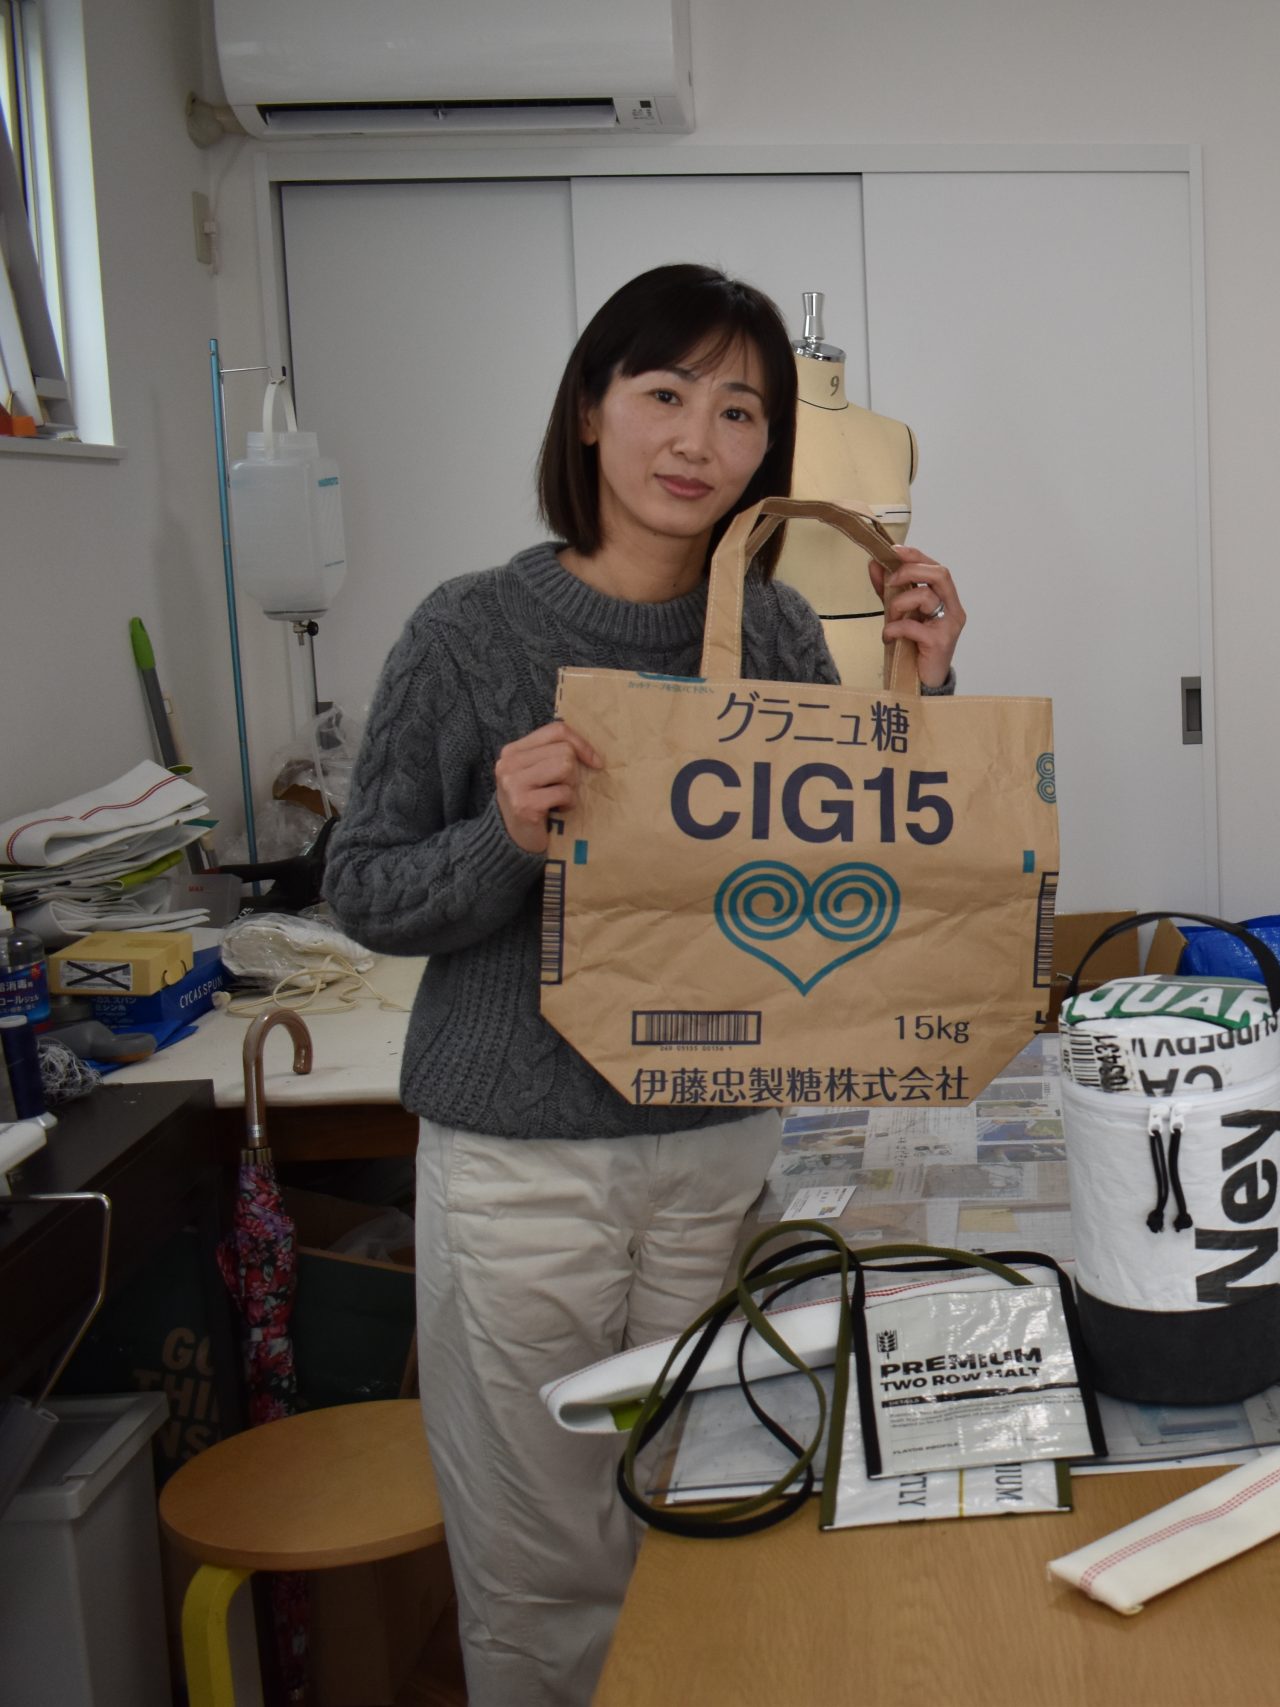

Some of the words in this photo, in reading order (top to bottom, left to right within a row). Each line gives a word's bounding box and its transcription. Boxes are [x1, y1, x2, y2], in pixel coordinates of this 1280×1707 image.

[830, 375, 840, 397] 9
[716, 691, 911, 755] グラニュ糖
[669, 757, 955, 846] CIG15
[179, 985, 203, 1009] CYCAS
[202, 975, 224, 999] SPUN
[894, 1013, 971, 1045] 15kg
[631, 1065, 971, 1106] 伊藤忠製糖株式会社
[880, 1347, 1043, 1379] PREMIUM
[880, 1376, 928, 1393] TWO
[931, 1370, 981, 1387] ROW
[986, 1365, 1041, 1380] MALT
[898, 1473, 928, 1508] TLY
[994, 1463, 1024, 1503] IUM
